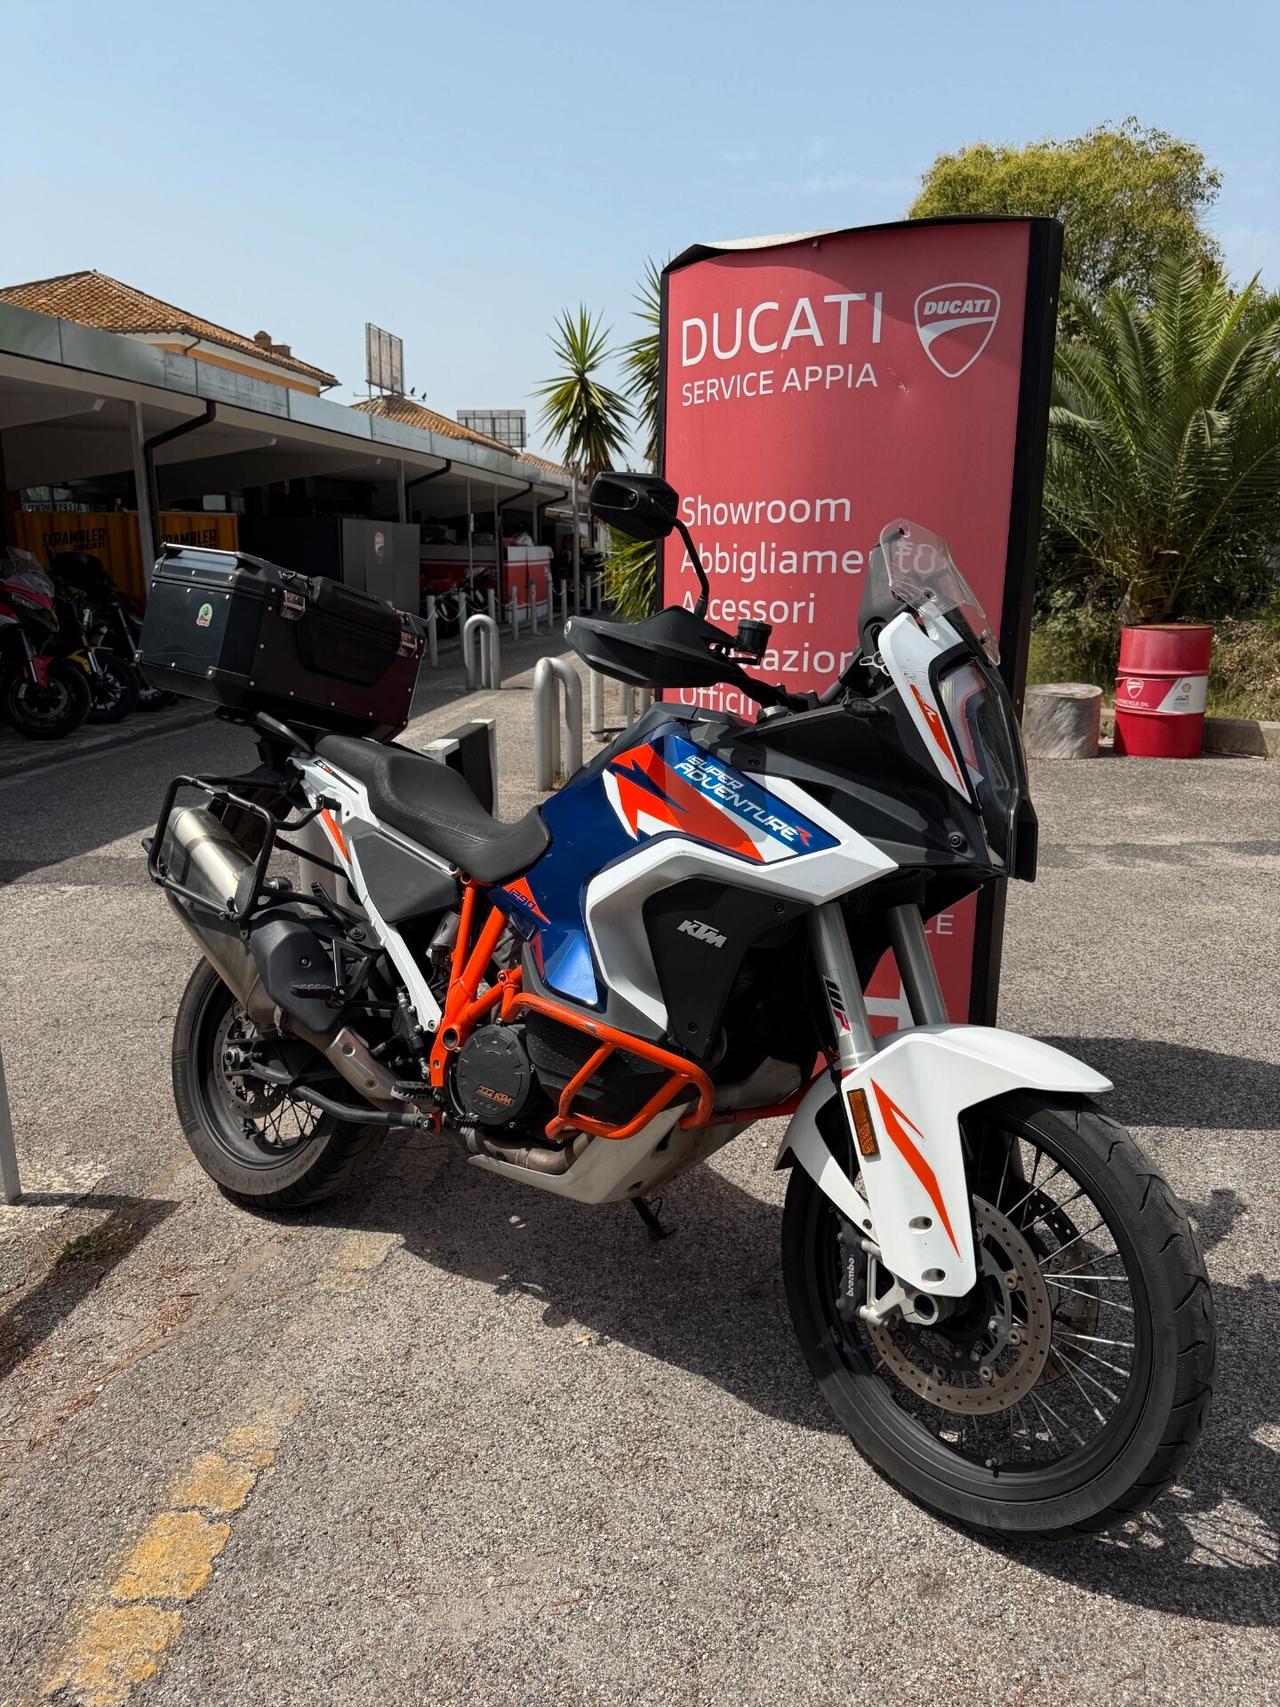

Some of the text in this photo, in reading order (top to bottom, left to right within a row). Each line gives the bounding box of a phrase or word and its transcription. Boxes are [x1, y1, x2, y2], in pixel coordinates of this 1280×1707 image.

[923, 299, 992, 315] DUCATI
[682, 292, 883, 367] DUCATI
[682, 363, 878, 407] SERVICE APPIA
[681, 495, 851, 527] Showroom
[681, 541, 938, 582] Abbigliameto
[682, 591, 816, 624] Acessori
[686, 754, 744, 790] SUPER
[673, 762, 798, 842] ADVENTURE
[677, 919, 728, 948] KTM
[845, 1256, 856, 1298] brembo
